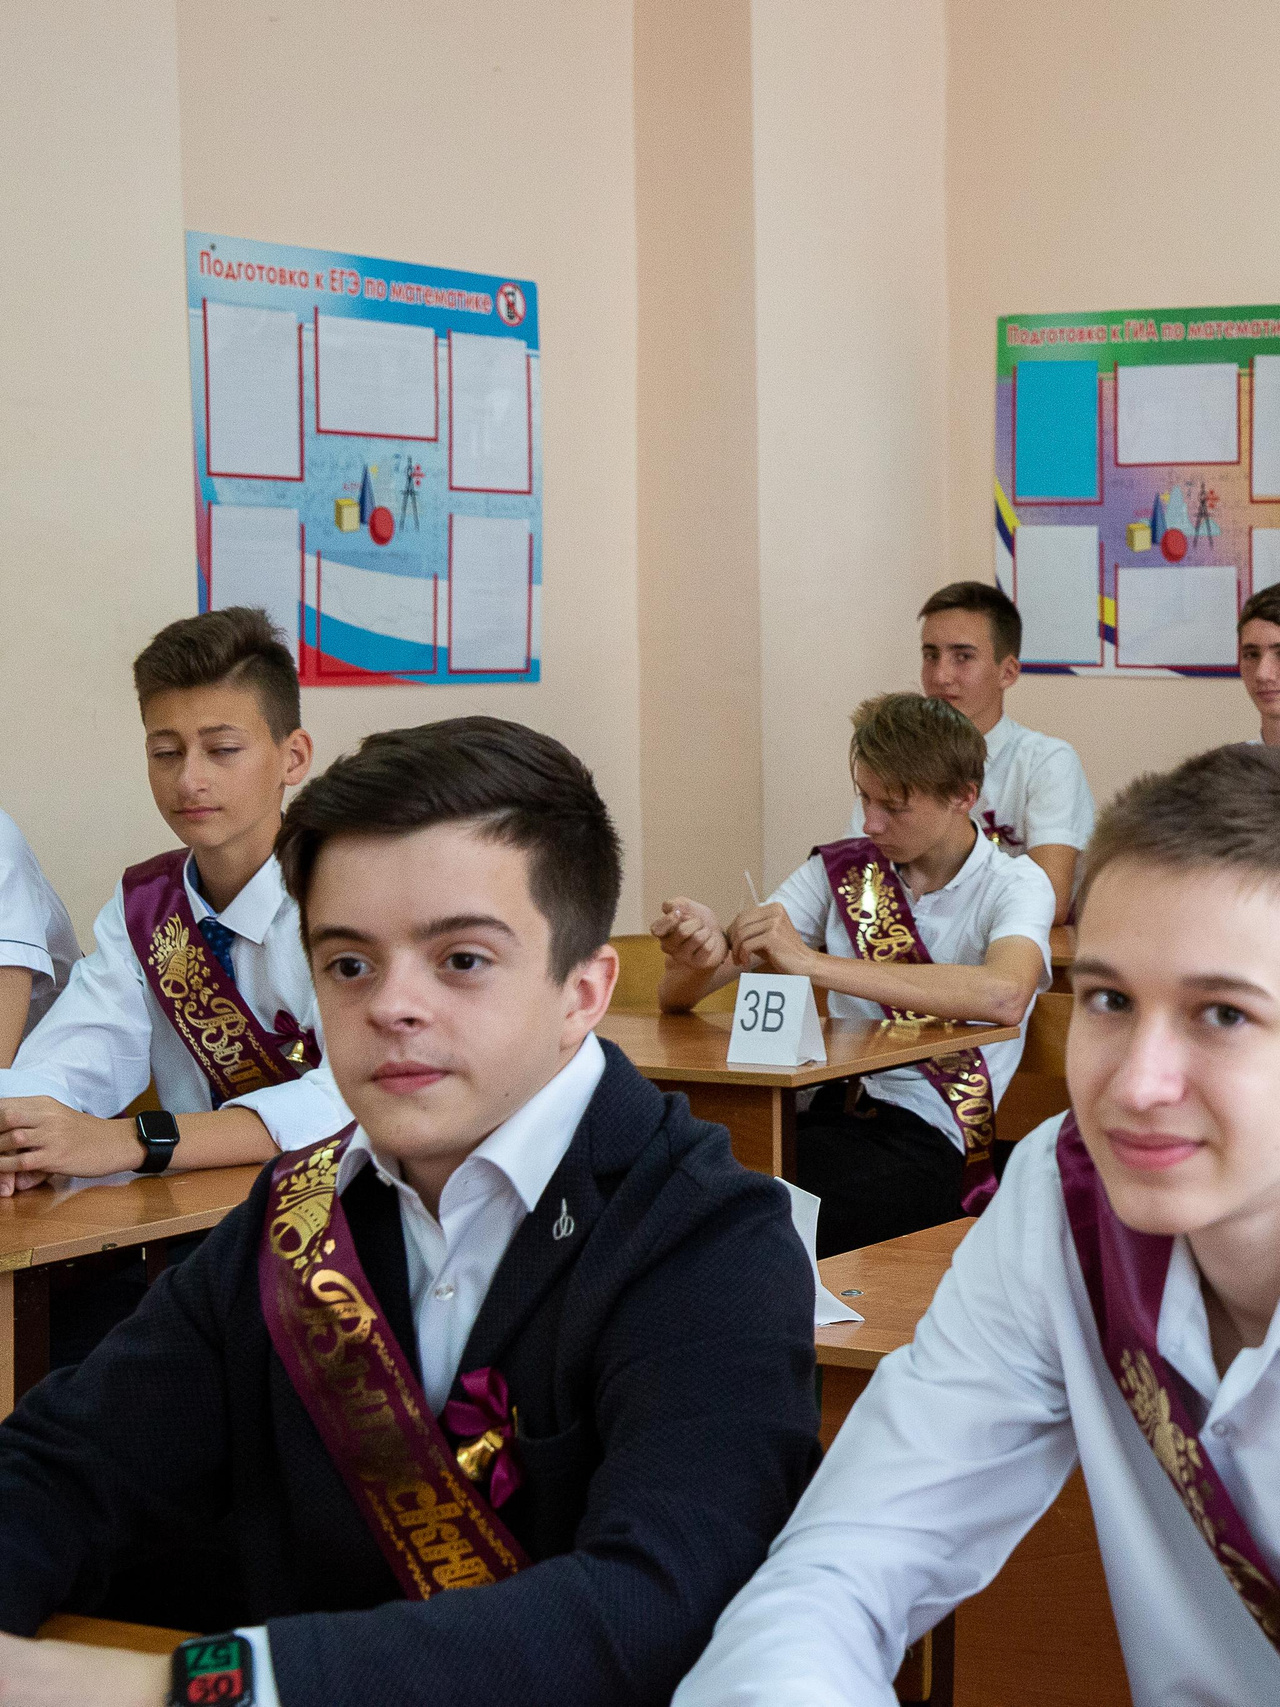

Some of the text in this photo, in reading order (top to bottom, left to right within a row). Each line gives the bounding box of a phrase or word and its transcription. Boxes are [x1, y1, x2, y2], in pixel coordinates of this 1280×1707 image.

[200, 250, 493, 315] Подготовка к ЕГЭ по математике
[1007, 325, 1107, 347] Подготовка
[1110, 327, 1124, 343] к
[1124, 318, 1160, 343] ГИА
[1161, 322, 1186, 343] по
[942, 1072, 993, 1168] 2021
